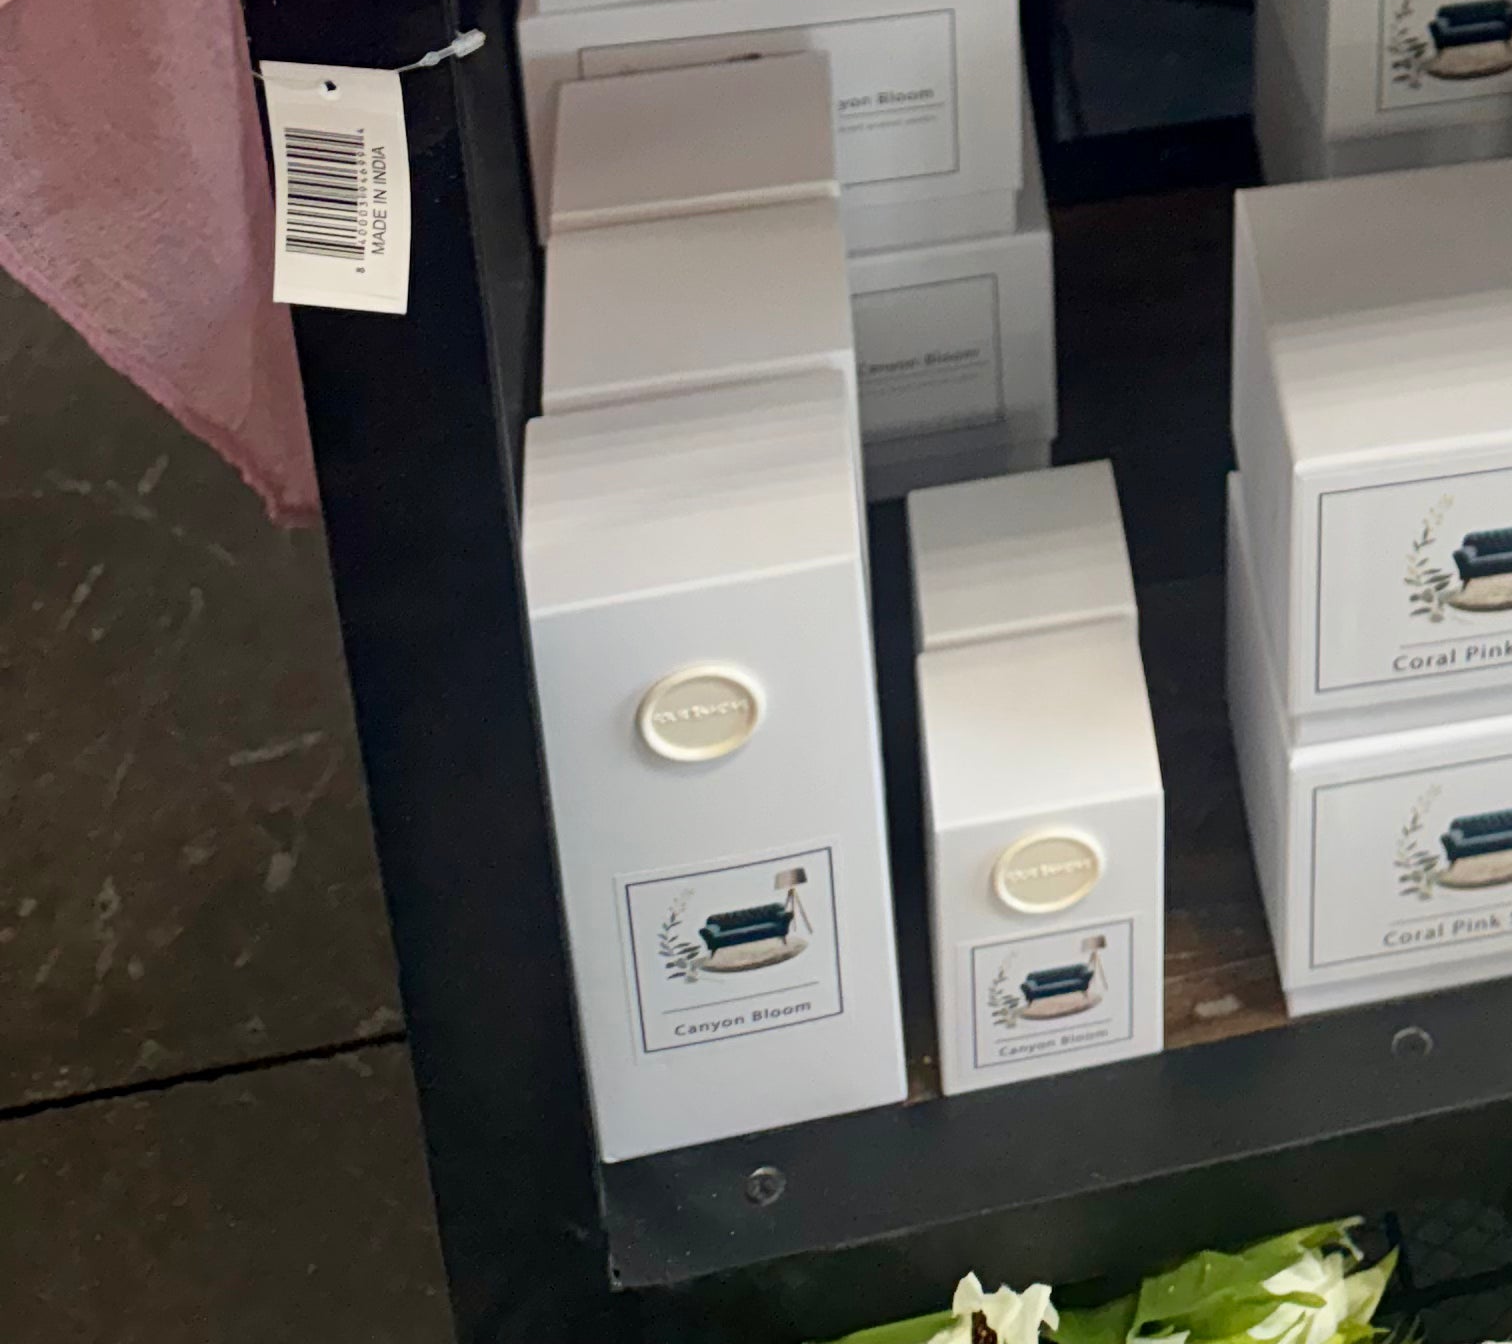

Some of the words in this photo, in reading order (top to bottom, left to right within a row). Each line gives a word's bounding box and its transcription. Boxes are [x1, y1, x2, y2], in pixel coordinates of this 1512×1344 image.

[371, 146, 386, 185] INDIA
[372, 188, 387, 204] IN
[371, 208, 387, 255] MADE
[1392, 648, 1457, 672] Coral
[1383, 923, 1444, 947] Coral
[1452, 914, 1501, 935] Pink
[674, 1015, 745, 1036] Canyon
[752, 1001, 812, 1022] Bloom
[998, 1040, 1057, 1056] Canyon
